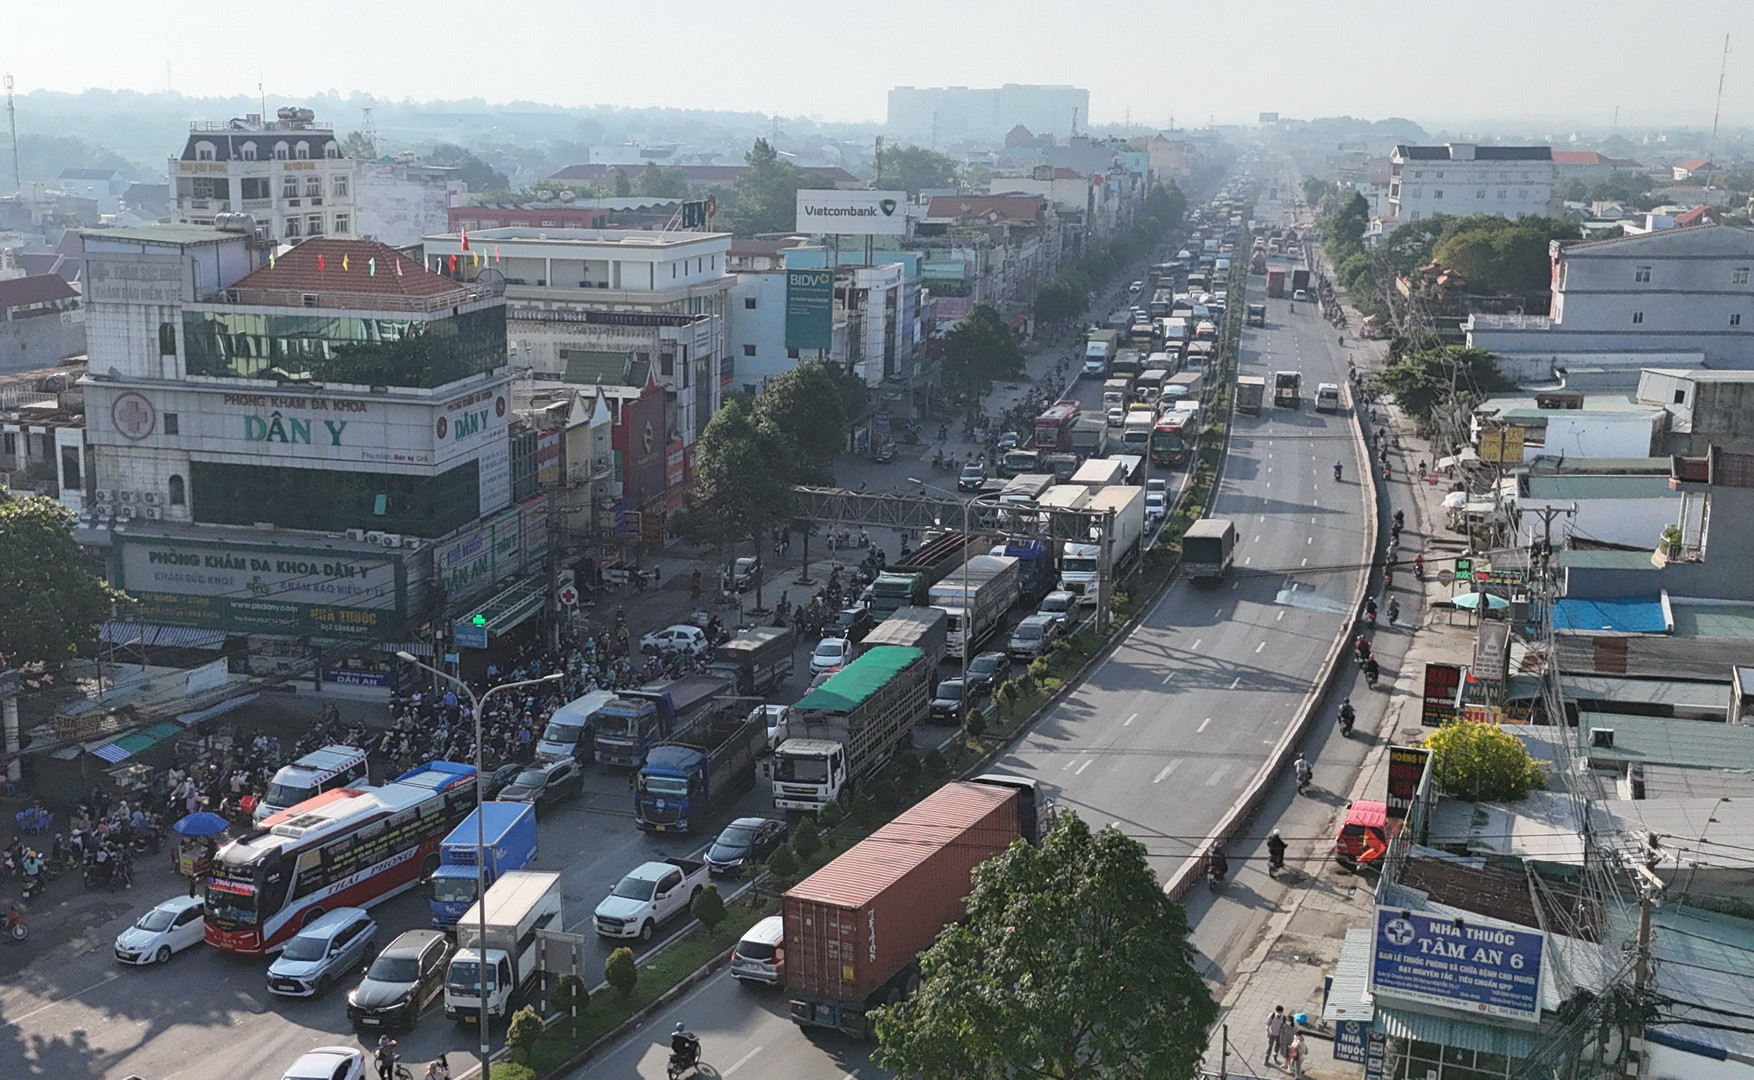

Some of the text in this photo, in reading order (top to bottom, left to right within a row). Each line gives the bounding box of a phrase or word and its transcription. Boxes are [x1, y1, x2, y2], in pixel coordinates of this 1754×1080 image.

[804, 205, 877, 217] Vietcombank
[790, 274, 819, 286] BIDV
[333, 400, 367, 413] KHOA
[244, 410, 347, 446] DÂN Y
[454, 409, 489, 440] DÂN Y
[149, 549, 369, 579] PHÒNG KHÁM ĐA KHOA DÂN Y
[310, 606, 335, 621] NHÀ
[339, 610, 377, 625] THUỐC
[371, 850, 413, 875] PHONG
[1466, 926, 1515, 946] THUỐC
[1418, 937, 1524, 969] TÂM AN 6
[1478, 967, 1498, 978] BỆNH
[1498, 972, 1513, 980] CHO
[1498, 982, 1513, 991] GPP
